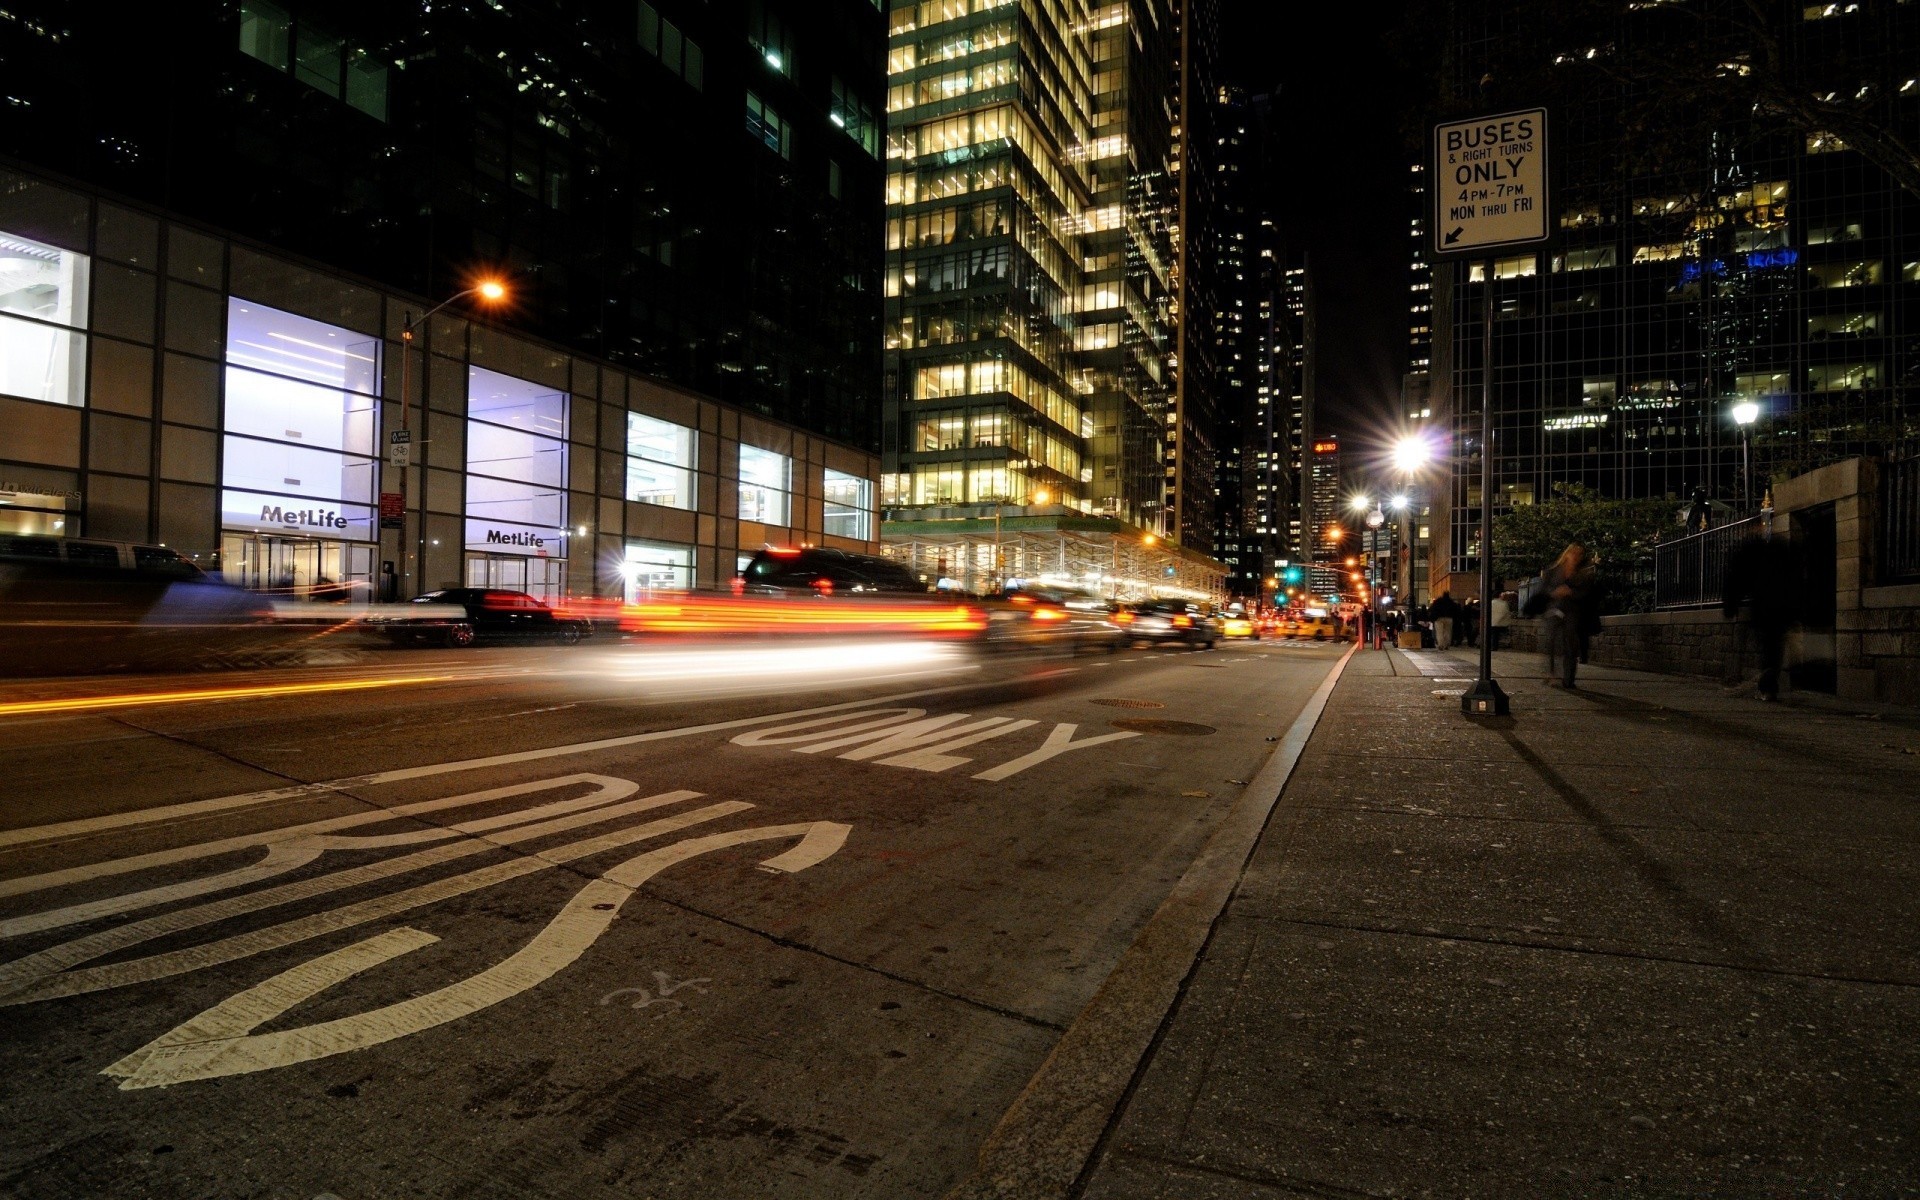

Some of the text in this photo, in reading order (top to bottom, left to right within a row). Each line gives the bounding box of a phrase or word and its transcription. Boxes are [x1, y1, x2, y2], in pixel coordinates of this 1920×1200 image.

[1447, 119, 1533, 151] BUSES
[1448, 141, 1533, 164] & RIGHT TURNS
[1455, 156, 1525, 185] ONLY
[1450, 196, 1533, 221] MON THRU FRI
[260, 504, 348, 529] MetLife
[487, 529, 544, 548] MetLife
[729, 707, 1144, 782] ONLY
